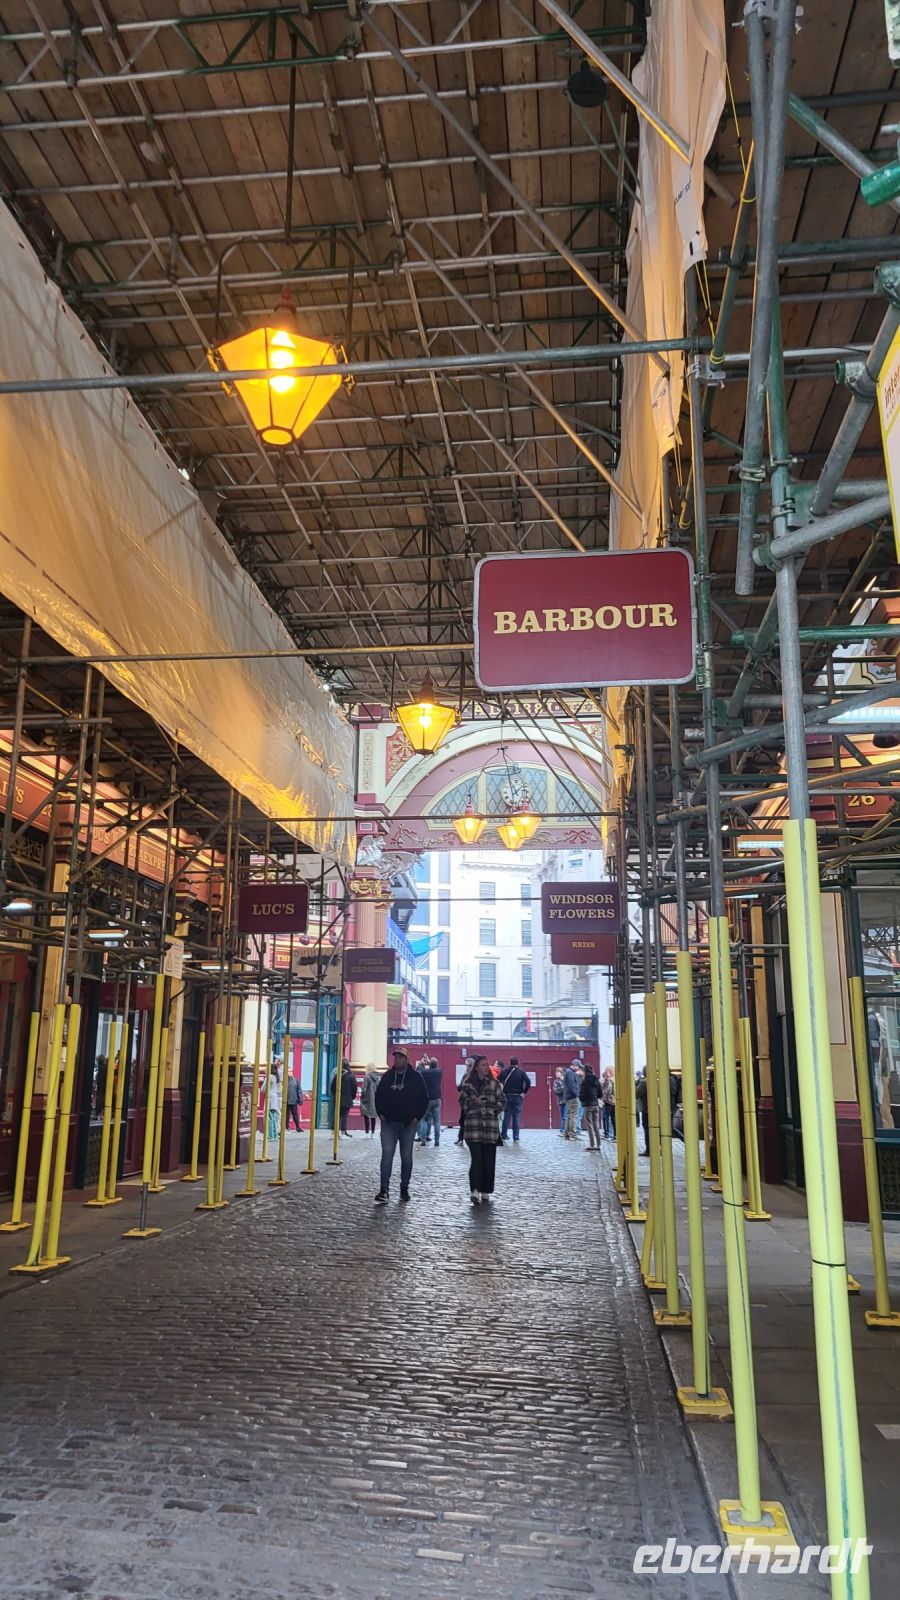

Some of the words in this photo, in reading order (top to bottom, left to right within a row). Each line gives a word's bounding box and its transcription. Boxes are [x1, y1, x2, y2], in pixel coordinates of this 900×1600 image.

[493, 603, 678, 634] BARBOUR
[848, 793, 876, 808] 26
[549, 895, 614, 905] WINDSOR
[251, 903, 295, 915] LUC'S
[548, 908, 615, 919] FLOWERS
[571, 941, 596, 949] REISS
